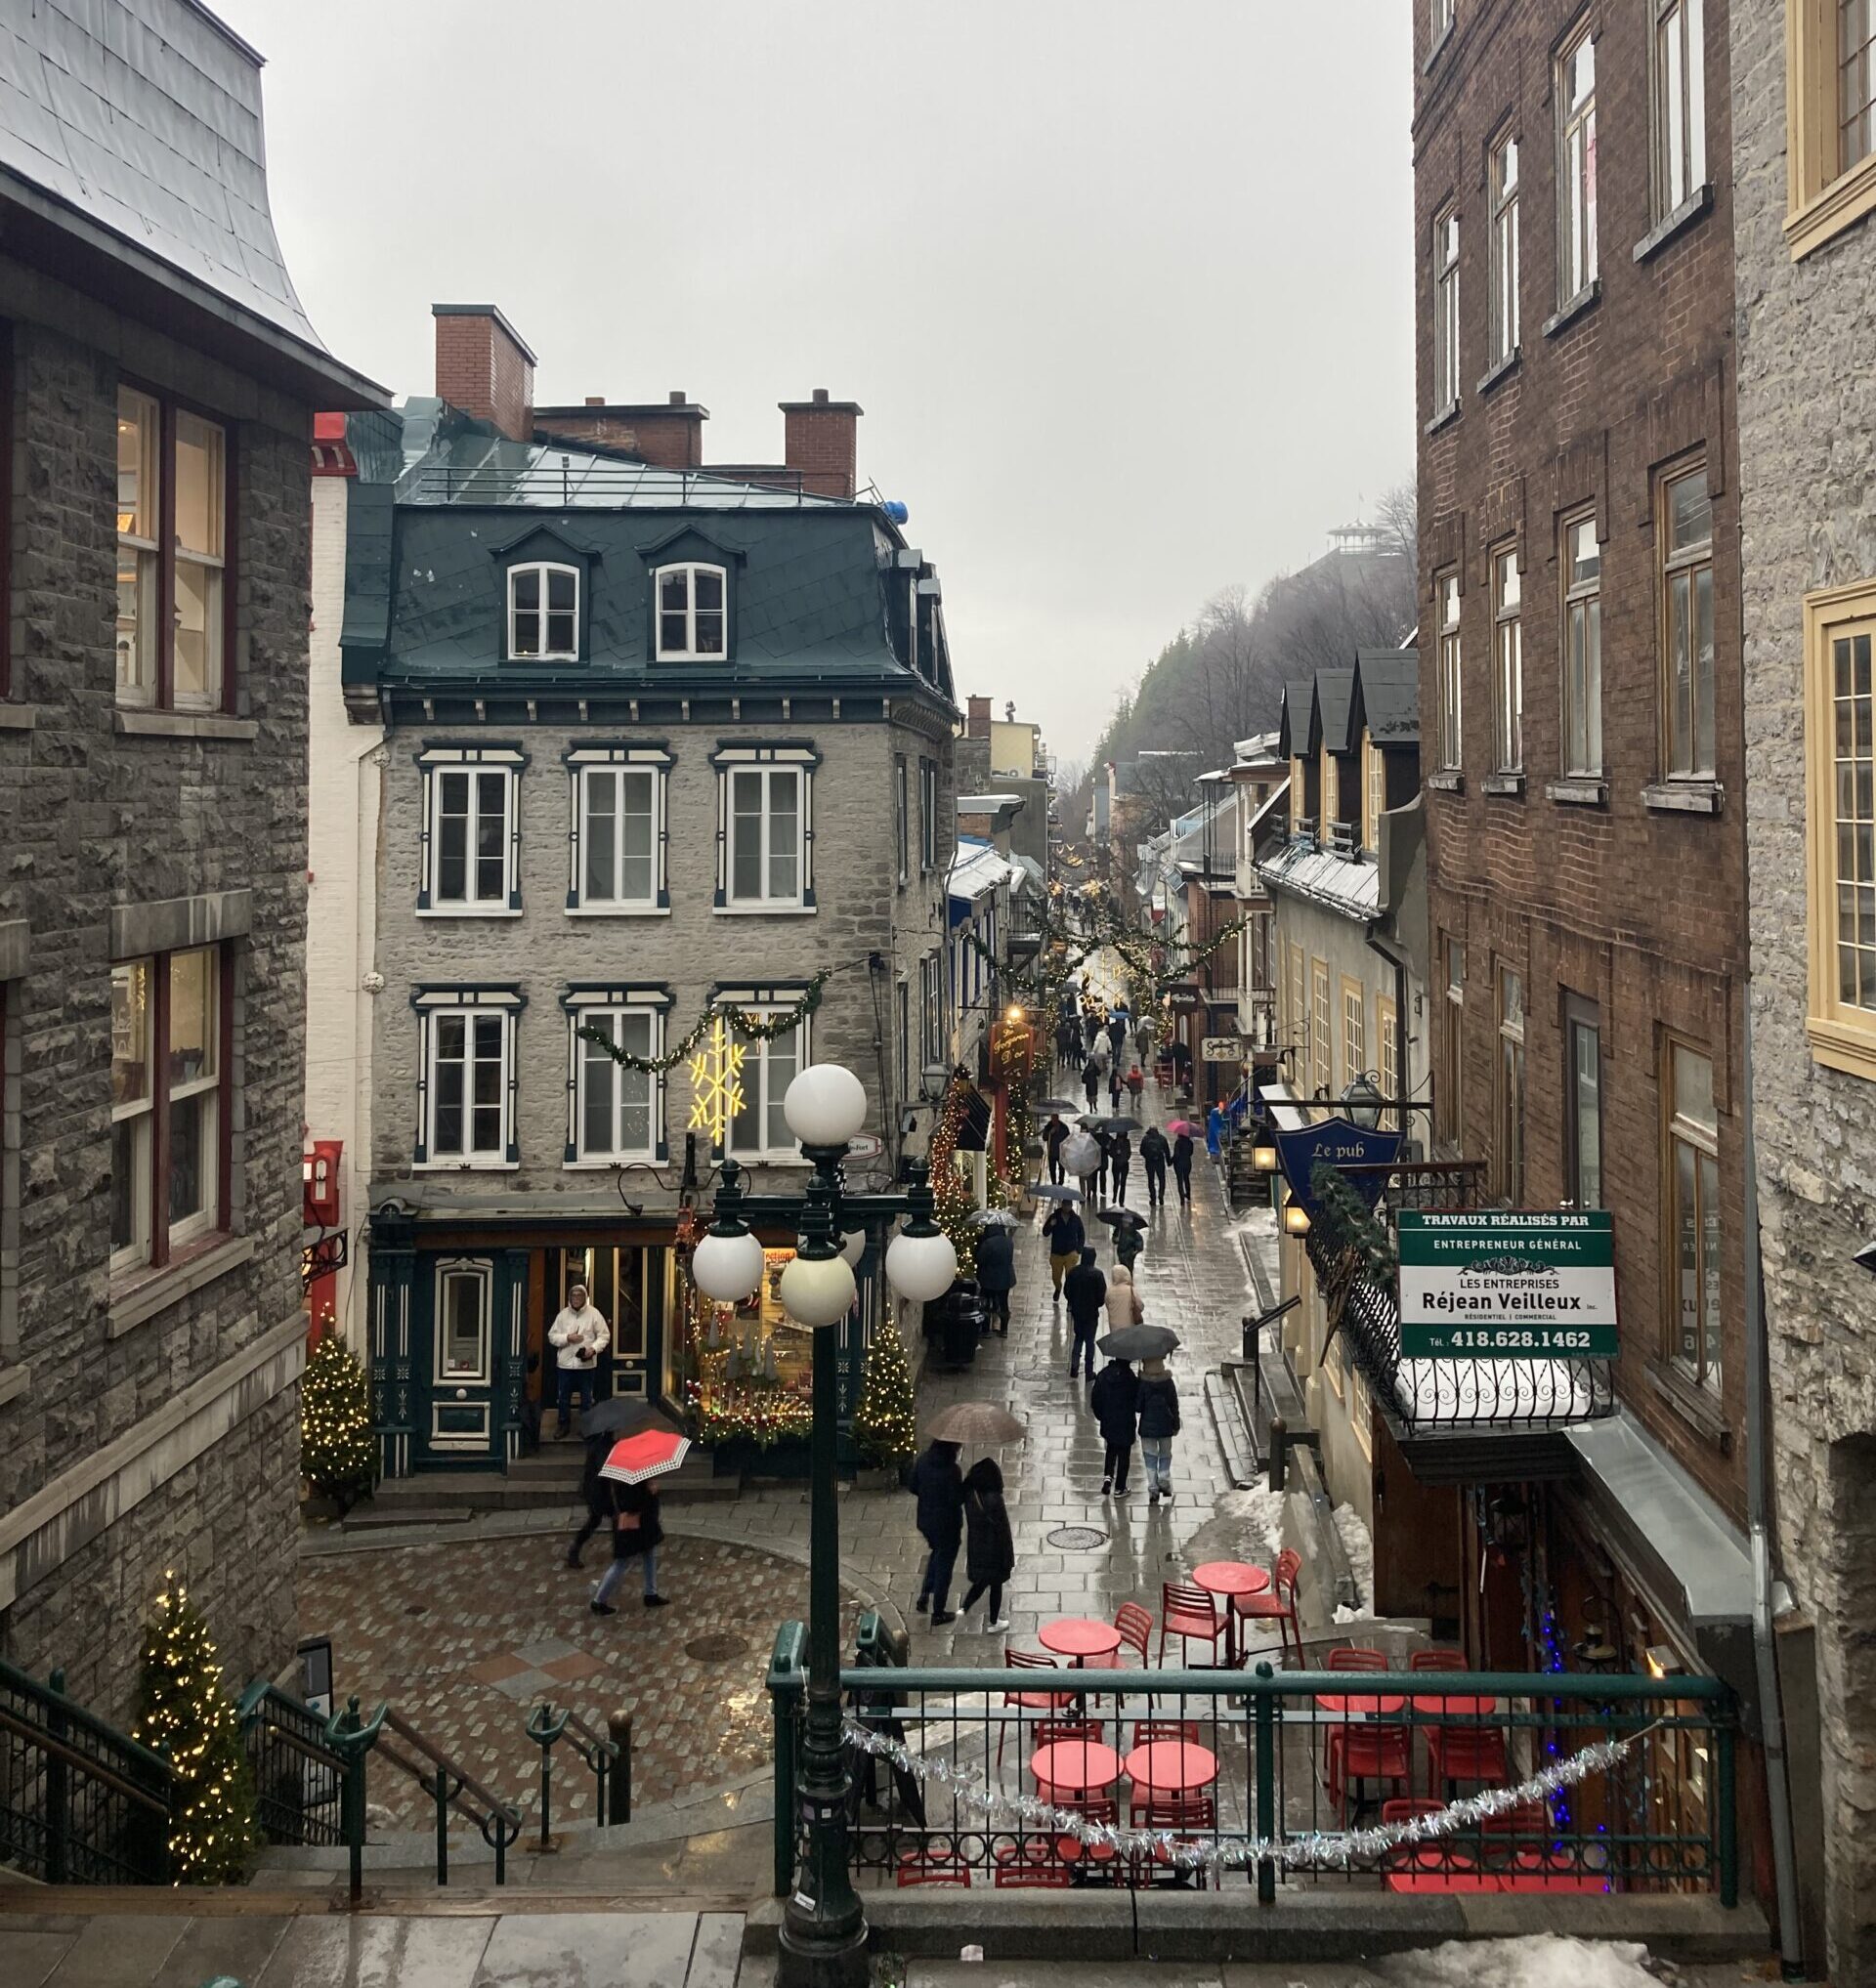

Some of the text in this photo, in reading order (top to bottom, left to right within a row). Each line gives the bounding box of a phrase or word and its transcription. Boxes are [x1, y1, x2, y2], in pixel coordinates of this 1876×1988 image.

[1311, 1141, 1365, 1161] Le pub
[1423, 1212, 1590, 1226] TRAVAUX RÉALISÉS PAR
[1433, 1238, 1582, 1250] ENTREPRENEUR GÉNÉRAL
[1460, 1279, 1559, 1289] LES ENTREPRISES
[1423, 1290, 1492, 1313] Réjean
[1497, 1291, 1581, 1310] Veilleux
[1451, 1331, 1591, 1348] 418.628.1462
